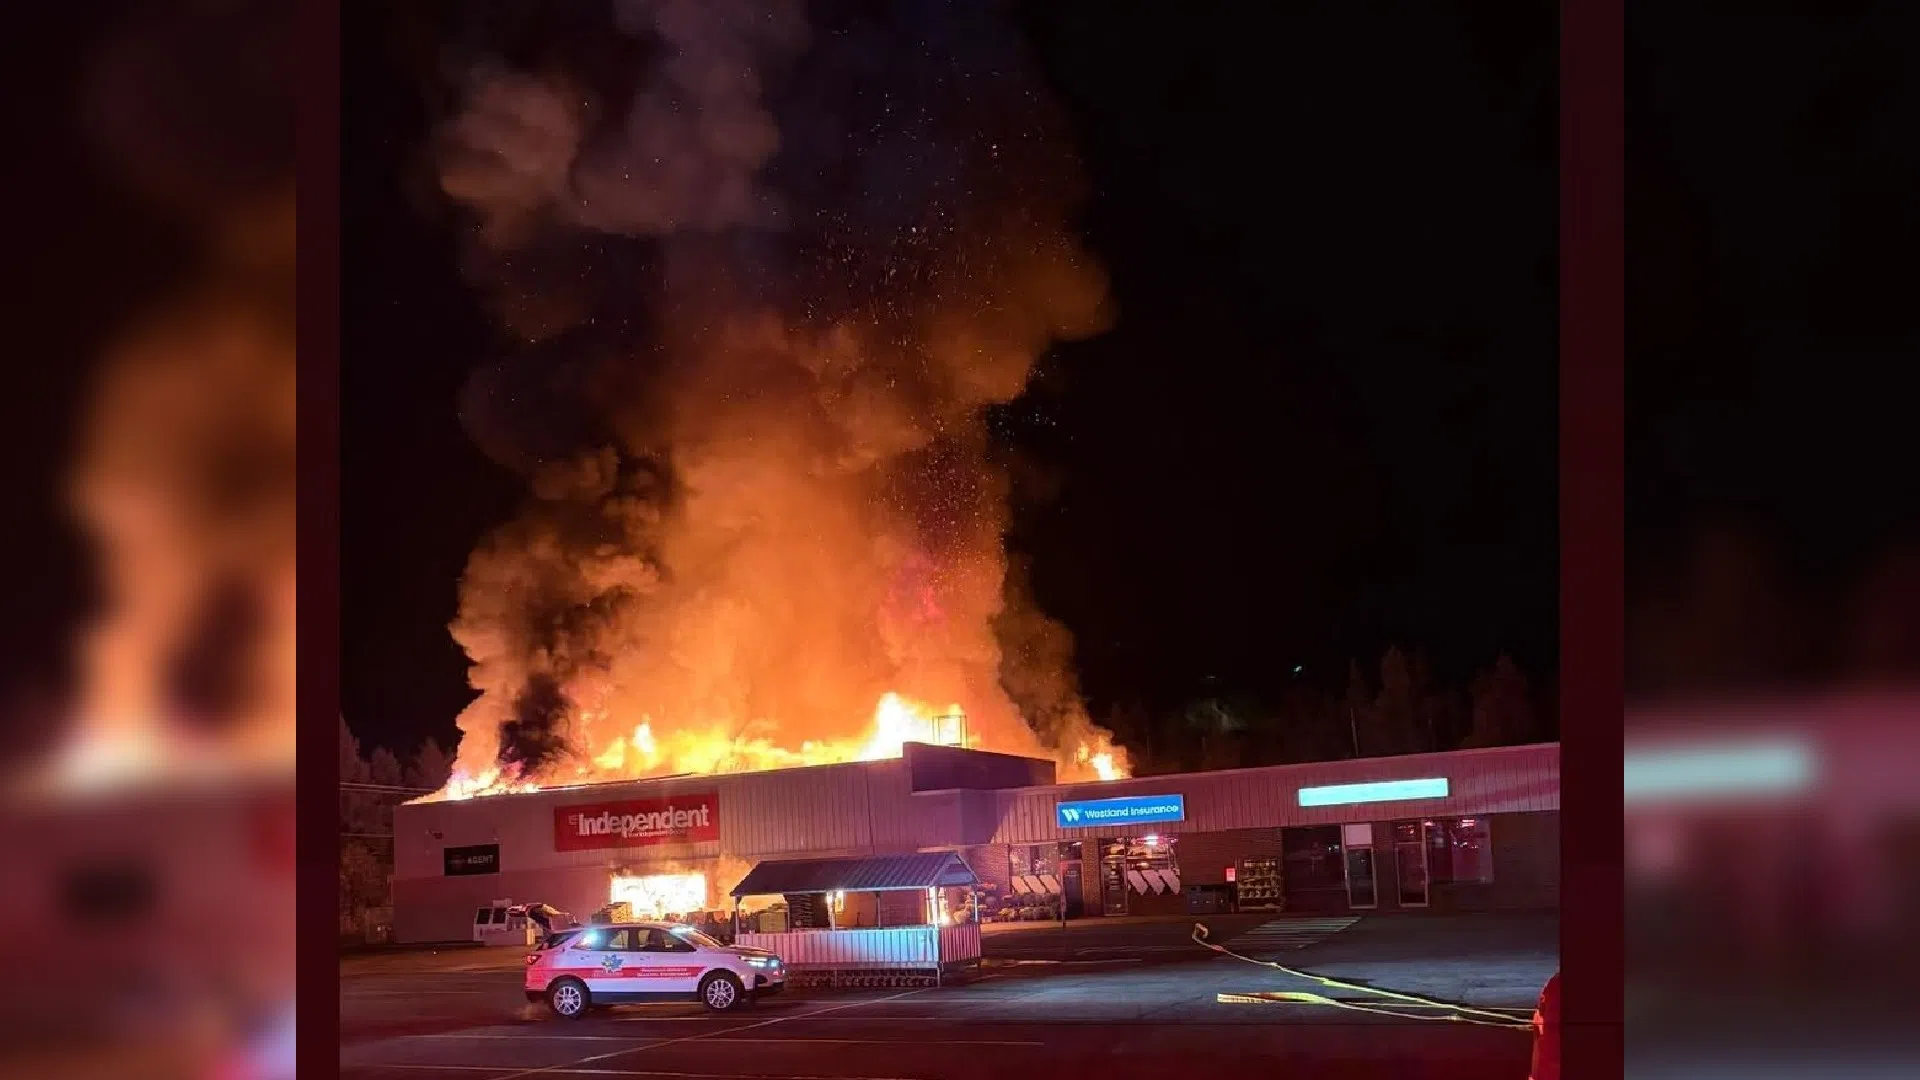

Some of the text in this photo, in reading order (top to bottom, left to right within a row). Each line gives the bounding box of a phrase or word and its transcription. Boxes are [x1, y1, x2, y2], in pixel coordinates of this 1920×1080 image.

[578, 804, 709, 838] Independent
[1085, 807, 1128, 819] Westland
[1131, 805, 1179, 816] Insurance
